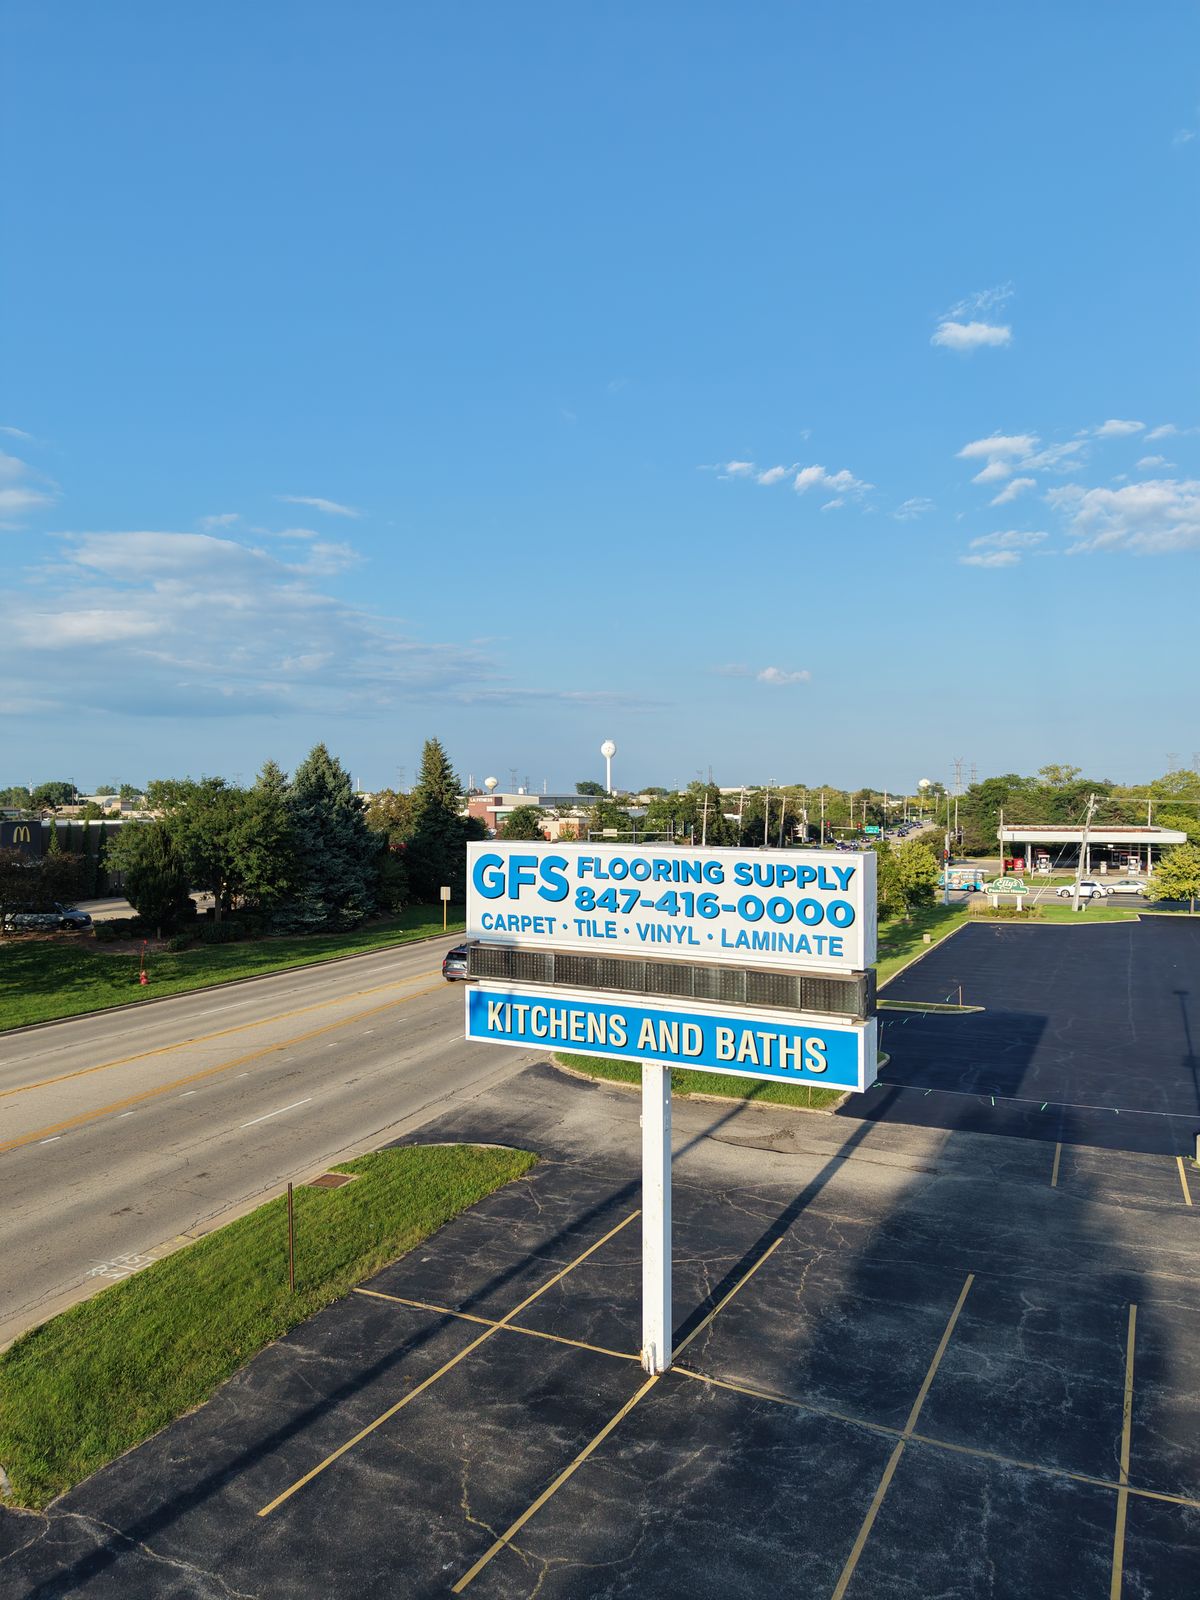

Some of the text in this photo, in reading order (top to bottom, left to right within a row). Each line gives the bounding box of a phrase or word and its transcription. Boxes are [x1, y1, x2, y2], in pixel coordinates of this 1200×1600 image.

[473, 853, 569, 902] GFS
[577, 856, 856, 891] FLOORING SUPPLY
[574, 886, 855, 928] 847-416-0000
[481, 912, 844, 957] CARPET TILE VINYL LAMINATE
[487, 1000, 828, 1074] KITCHENS AND BATHS
